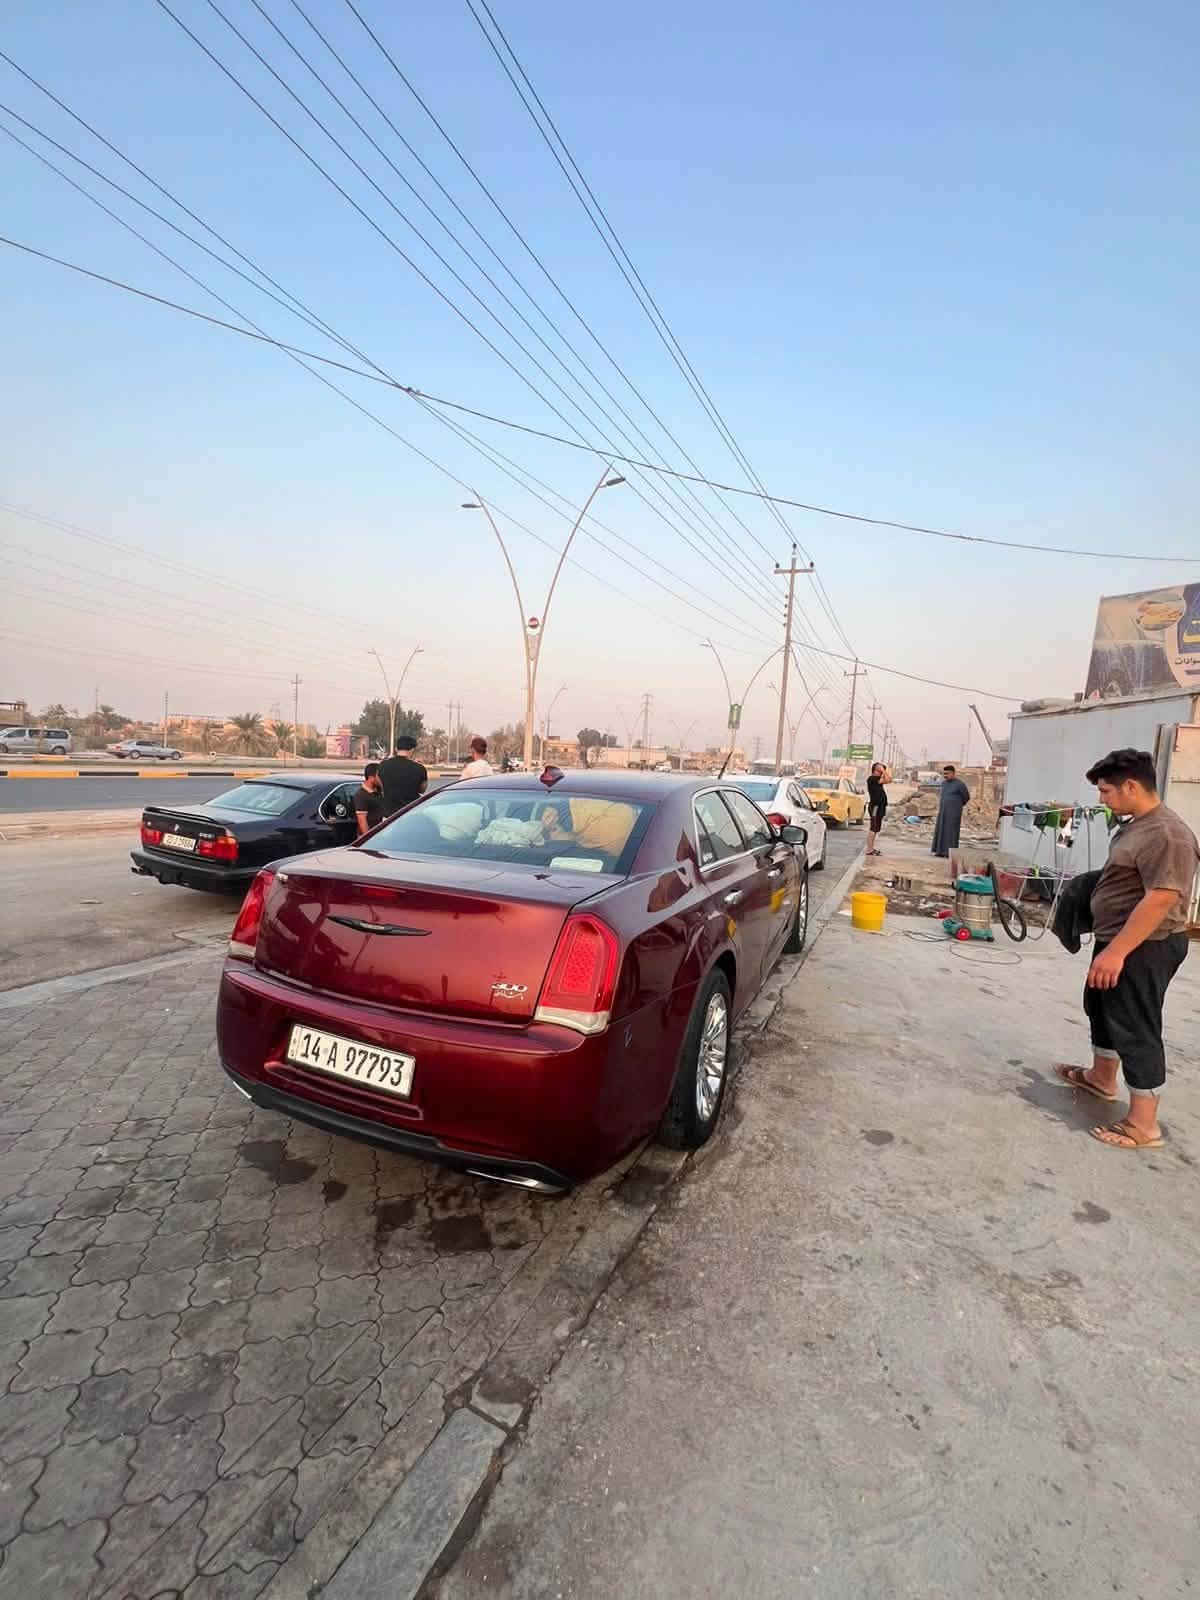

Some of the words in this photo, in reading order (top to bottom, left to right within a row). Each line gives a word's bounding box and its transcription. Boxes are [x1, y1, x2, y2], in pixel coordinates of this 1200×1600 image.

[300, 1033, 321, 1062] 14
[326, 1041, 338, 1068] A
[344, 1047, 405, 1086] 97793
